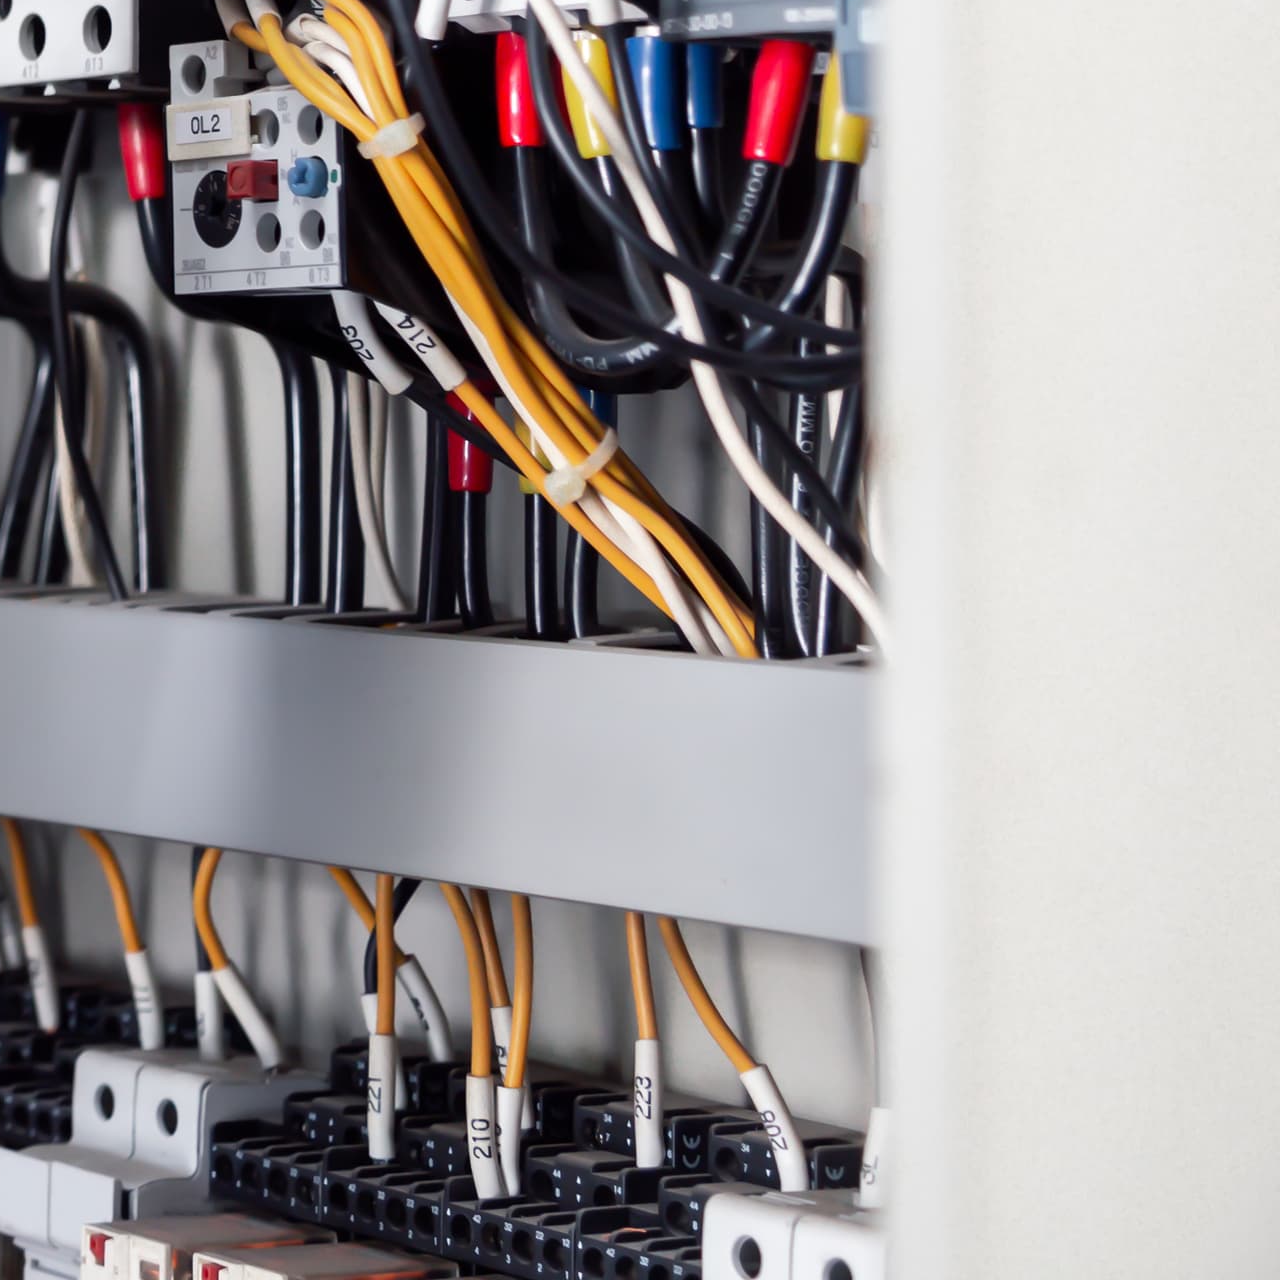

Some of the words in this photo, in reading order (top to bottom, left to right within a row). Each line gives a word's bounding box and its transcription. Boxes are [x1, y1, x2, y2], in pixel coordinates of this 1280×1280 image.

[204, 46, 218, 61] A2
[396, 314, 437, 354] 214
[368, 1077, 382, 1114] 221
[635, 1076, 652, 1120] 223
[471, 1118, 492, 1159] 210
